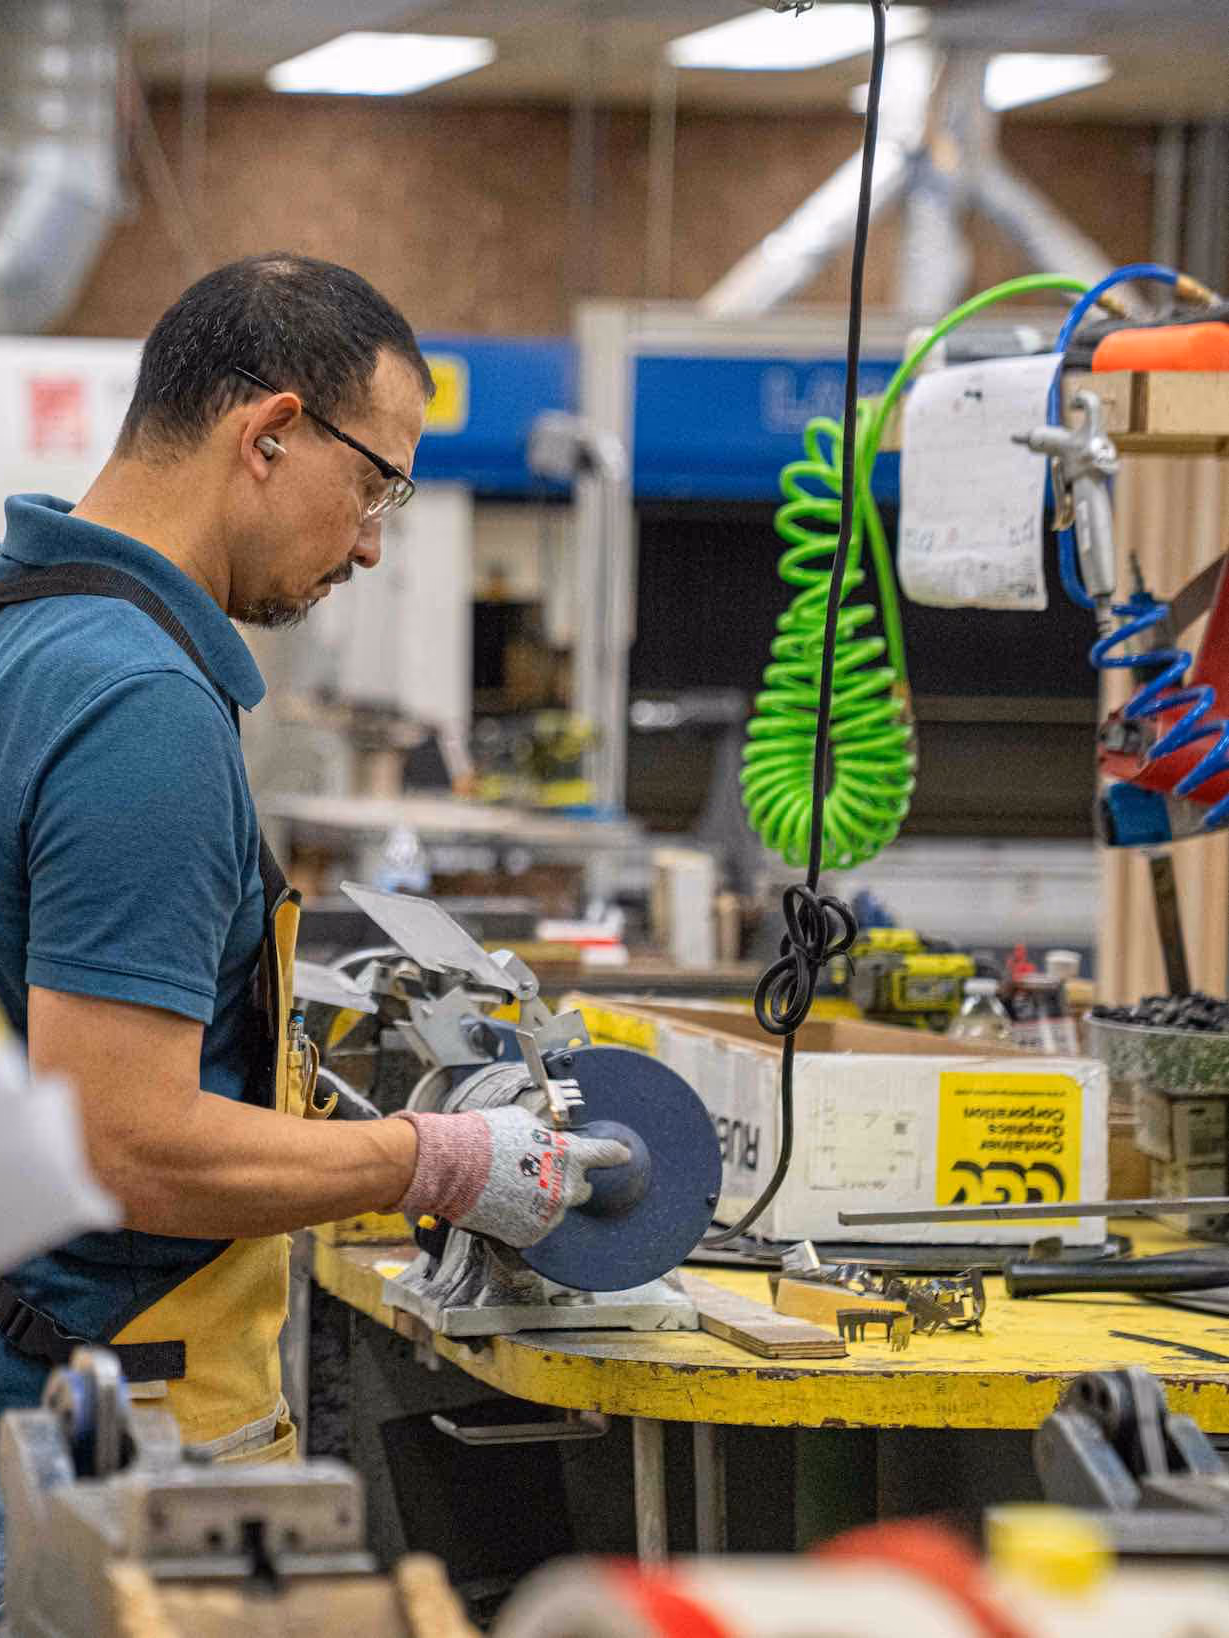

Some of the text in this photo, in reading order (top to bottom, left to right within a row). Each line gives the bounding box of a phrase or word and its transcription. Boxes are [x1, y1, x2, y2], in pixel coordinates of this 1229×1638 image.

[963, 1105, 1066, 1122] Corporation
[987, 1122, 1064, 1138] Graphics
[980, 1139, 1064, 1154] Container
